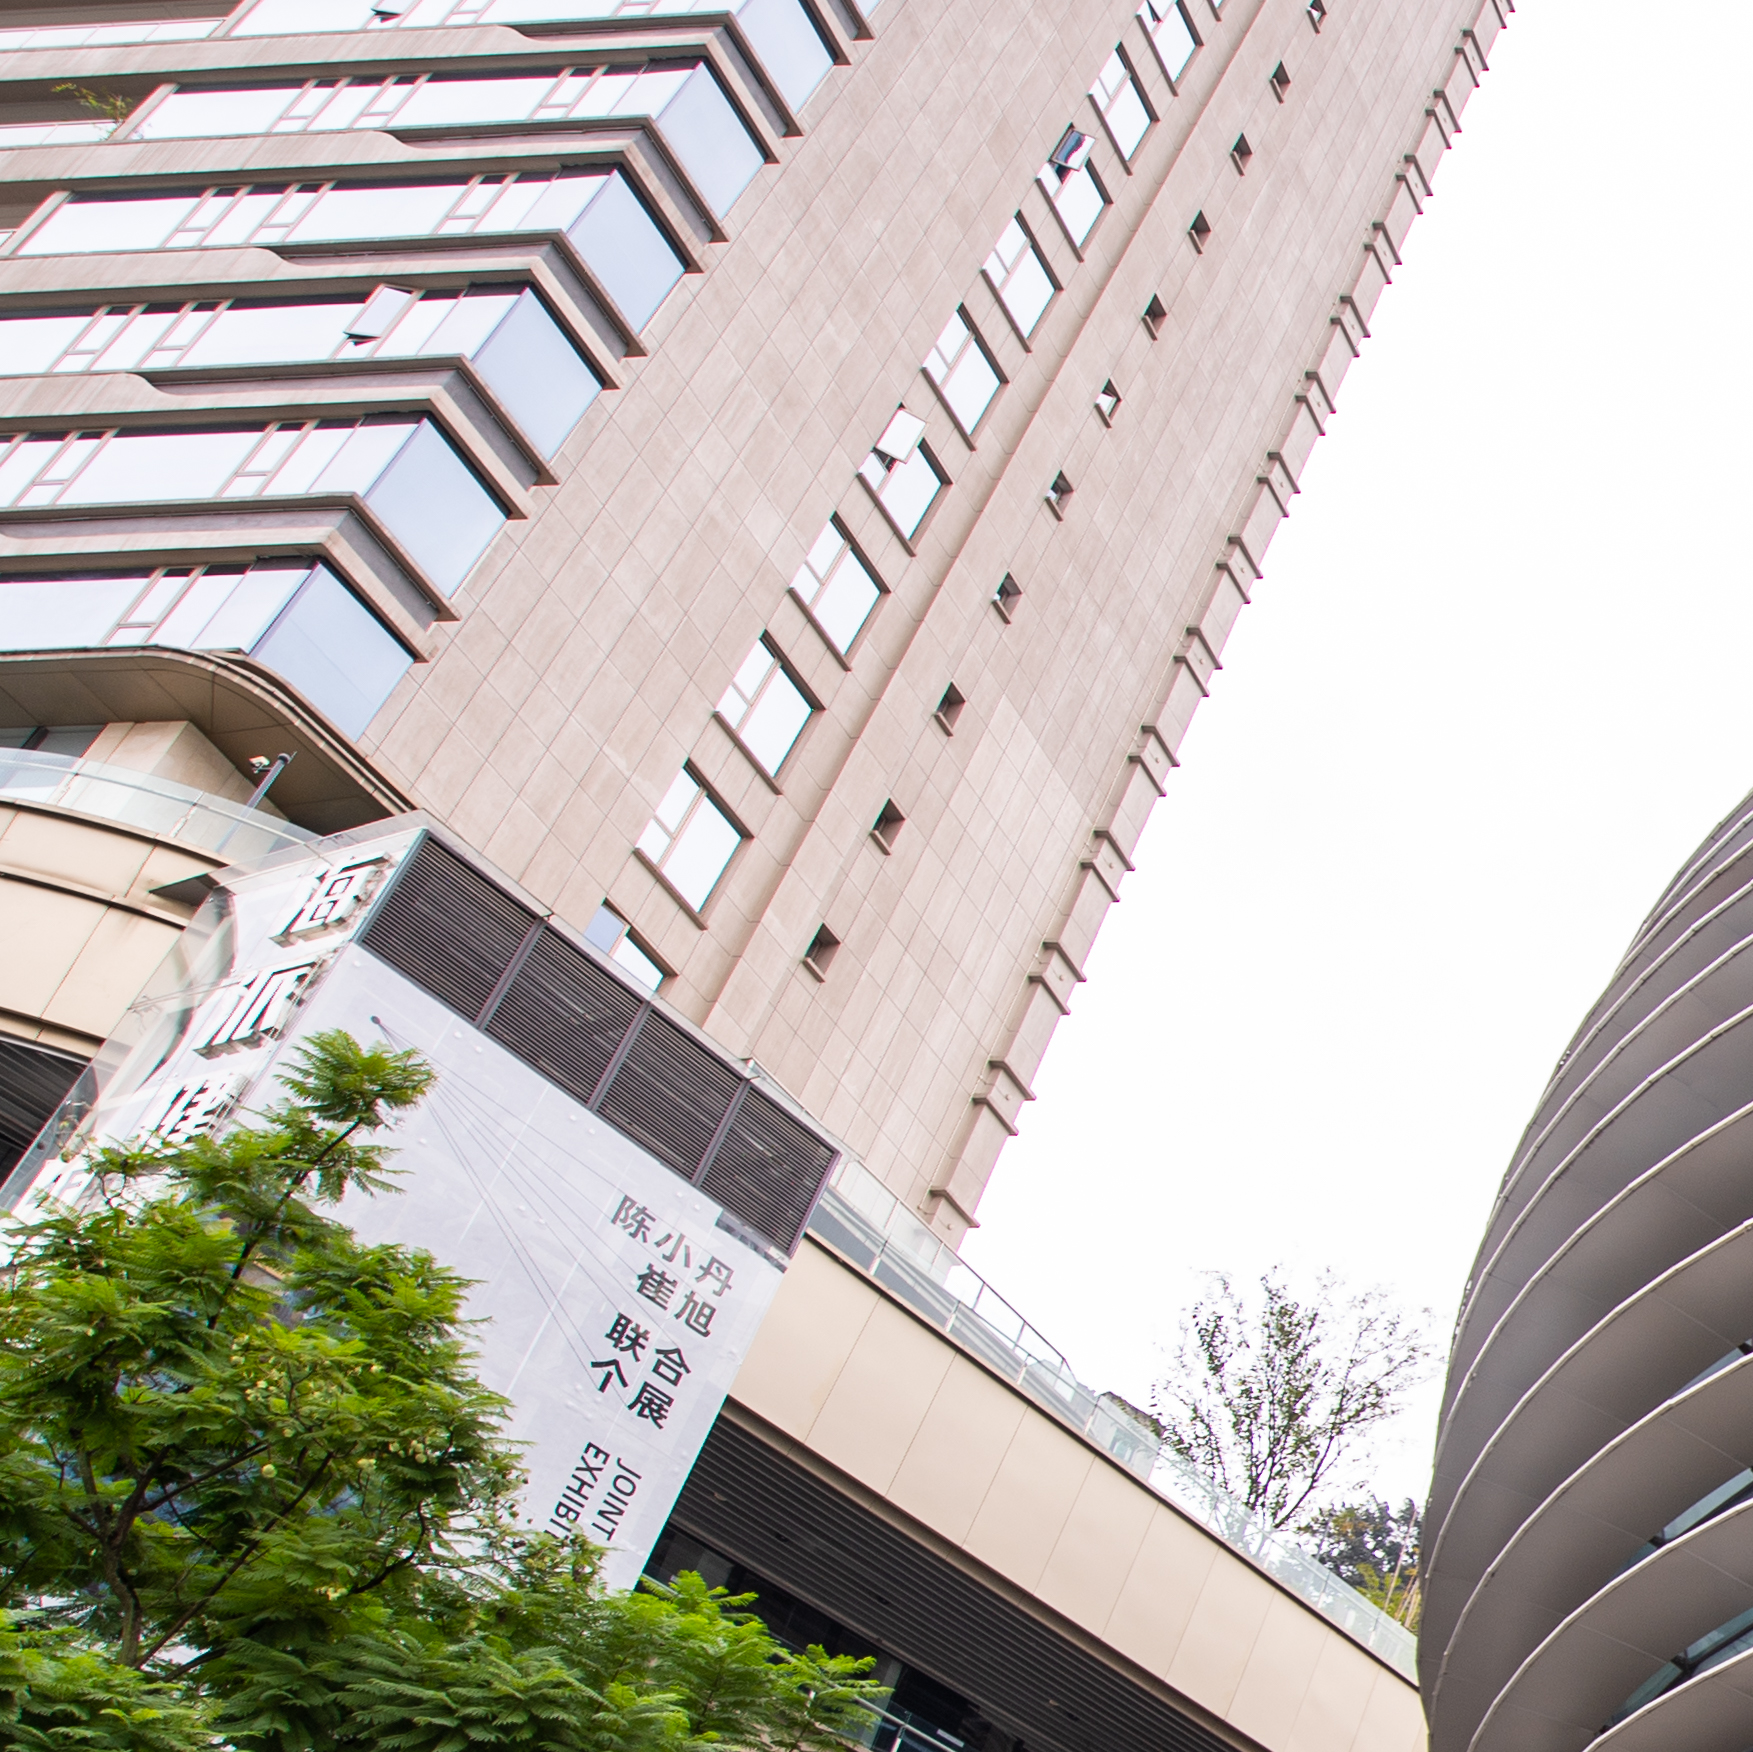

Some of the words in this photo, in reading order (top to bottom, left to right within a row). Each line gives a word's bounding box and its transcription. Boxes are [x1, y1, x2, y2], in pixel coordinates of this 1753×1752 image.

[611, 1195, 734, 1298] 陈小丹
[636, 1263, 718, 1338] 崔旭
[605, 1312, 692, 1388] 联合
[590, 1357, 675, 1430] 个展
[591, 1457, 642, 1542] JOINT
